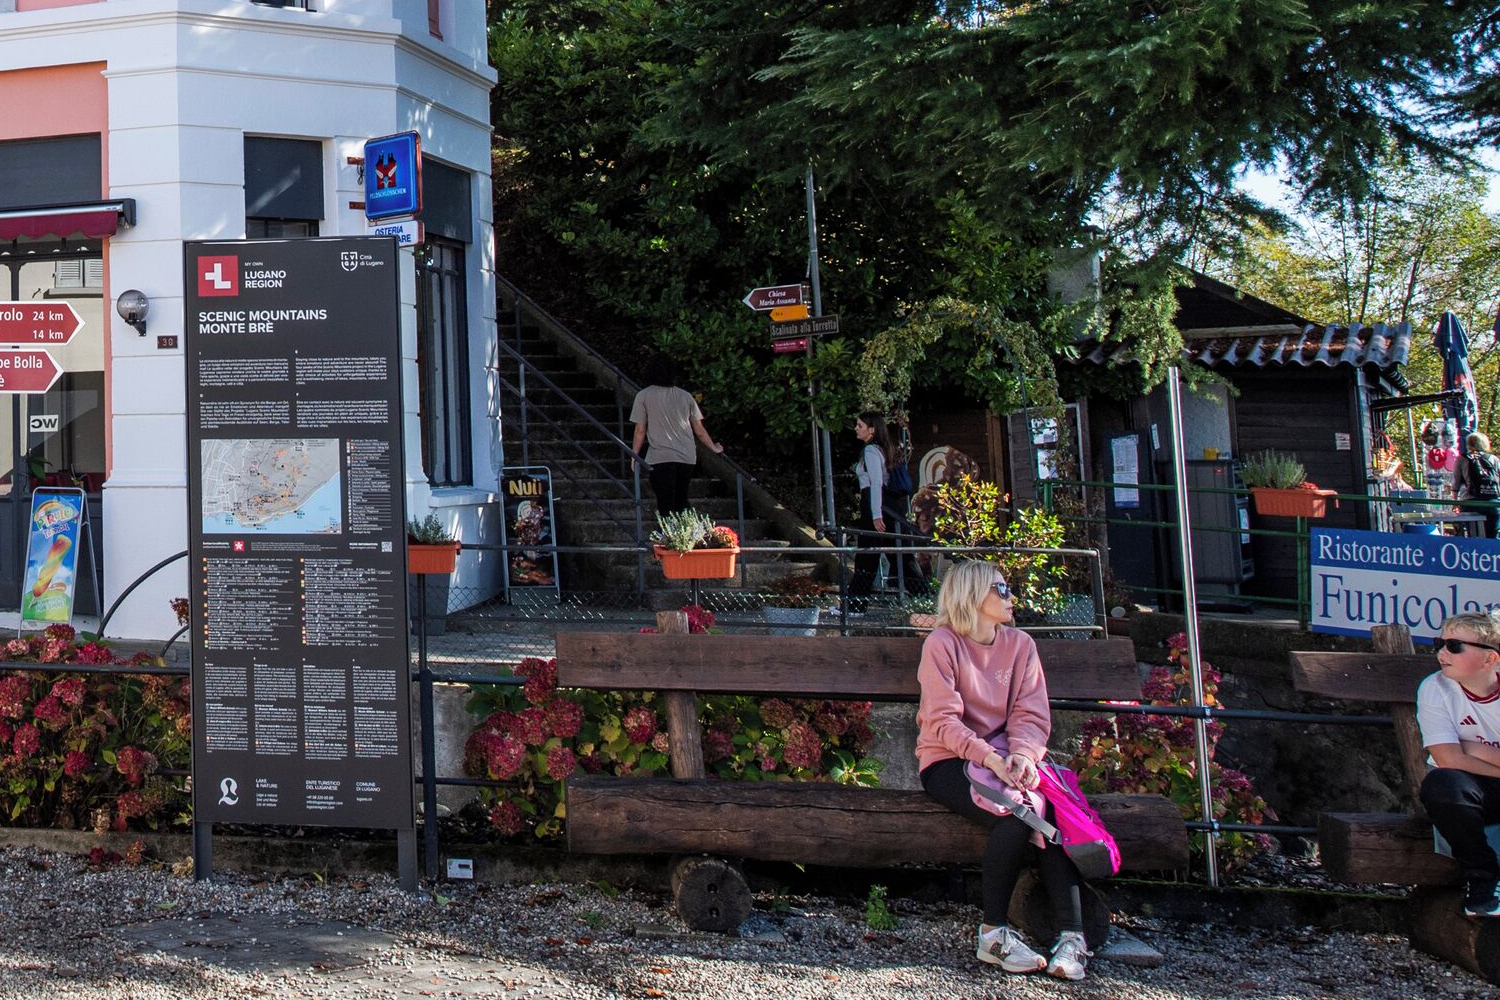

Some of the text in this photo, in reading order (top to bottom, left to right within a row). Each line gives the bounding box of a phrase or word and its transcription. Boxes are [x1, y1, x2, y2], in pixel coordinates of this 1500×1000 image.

[375, 225, 403, 236] OSTERIA
[245, 271, 286, 279] LUGANO
[245, 280, 283, 288] REGION
[33, 311, 44, 321] 24
[49, 311, 64, 321] km
[199, 309, 327, 322] SCENIC MOUNTAINS
[200, 320, 273, 334] MONTE BRÈ
[800, 322, 811, 332] alla
[33, 330, 44, 340] 14
[49, 329, 64, 340] km
[162, 338, 173, 346] 30
[14, 356, 43, 369] Bolla
[1318, 534, 1424, 567] Ristorante
